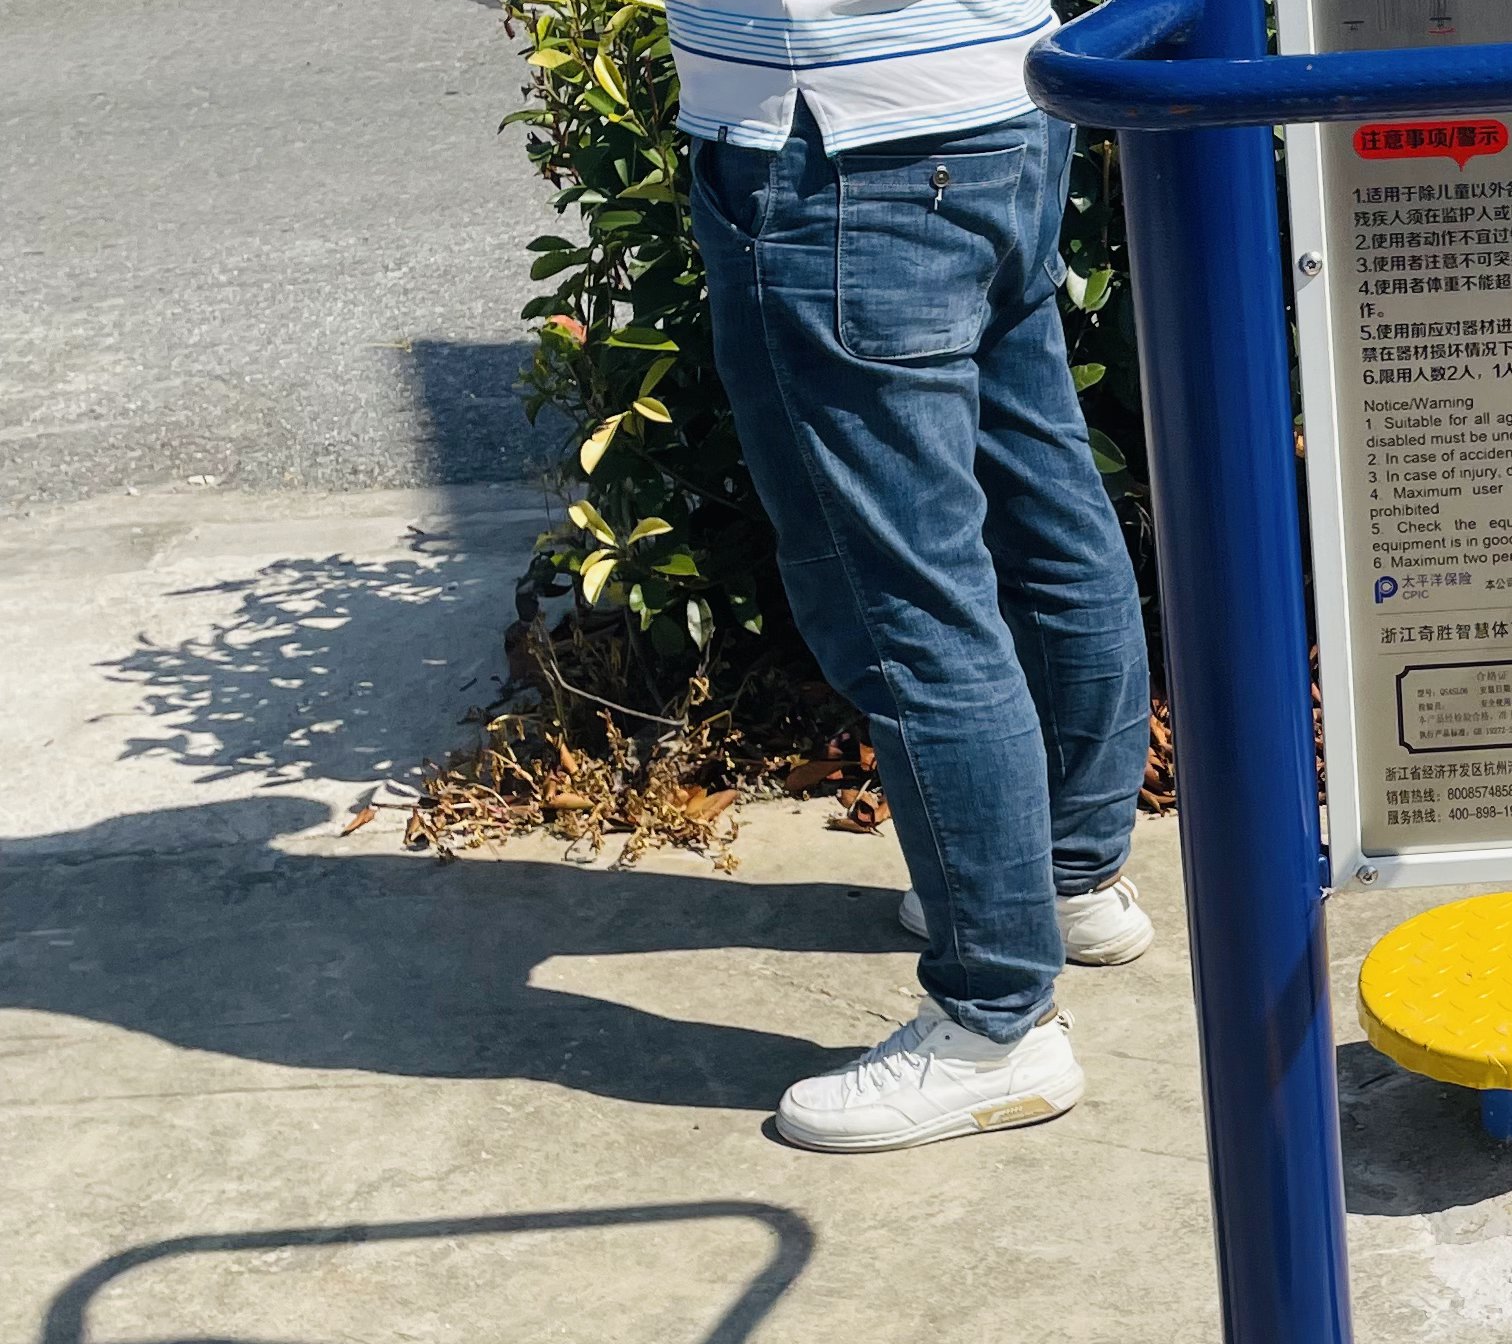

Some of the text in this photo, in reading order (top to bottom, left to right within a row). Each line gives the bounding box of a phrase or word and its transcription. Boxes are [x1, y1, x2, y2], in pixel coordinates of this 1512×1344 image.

[1361, 126, 1500, 151] 注意事项/警示
[1360, 302, 1384, 319] 作。
[1363, 397, 1474, 413] Notice/Warning
[1384, 414, 1443, 430] Suitable
[1448, 413, 1469, 427] for
[1474, 411, 1490, 425] all
[1366, 432, 1426, 449] disabled
[1430, 431, 1466, 445] must
[1469, 430, 1488, 443] be
[1385, 452, 1399, 465] In
[1402, 453, 1437, 464] case
[1440, 448, 1456, 462] of
[1386, 470, 1400, 483] In
[1403, 470, 1437, 482] case
[1441, 466, 1456, 480] of
[1393, 486, 1462, 500] Maximum
[1472, 484, 1504, 496] user
[1397, 519, 1442, 534] Check
[1454, 518, 1477, 531] the
[1372, 536, 1447, 554] equipment
[1450, 538, 1462, 548] is
[1466, 537, 1478, 547] in
[1390, 555, 1459, 568] Maximum
[1463, 552, 1488, 565] two
[1402, 571, 1472, 588] 太平洋保险
[1402, 589, 1429, 600] CPIC
